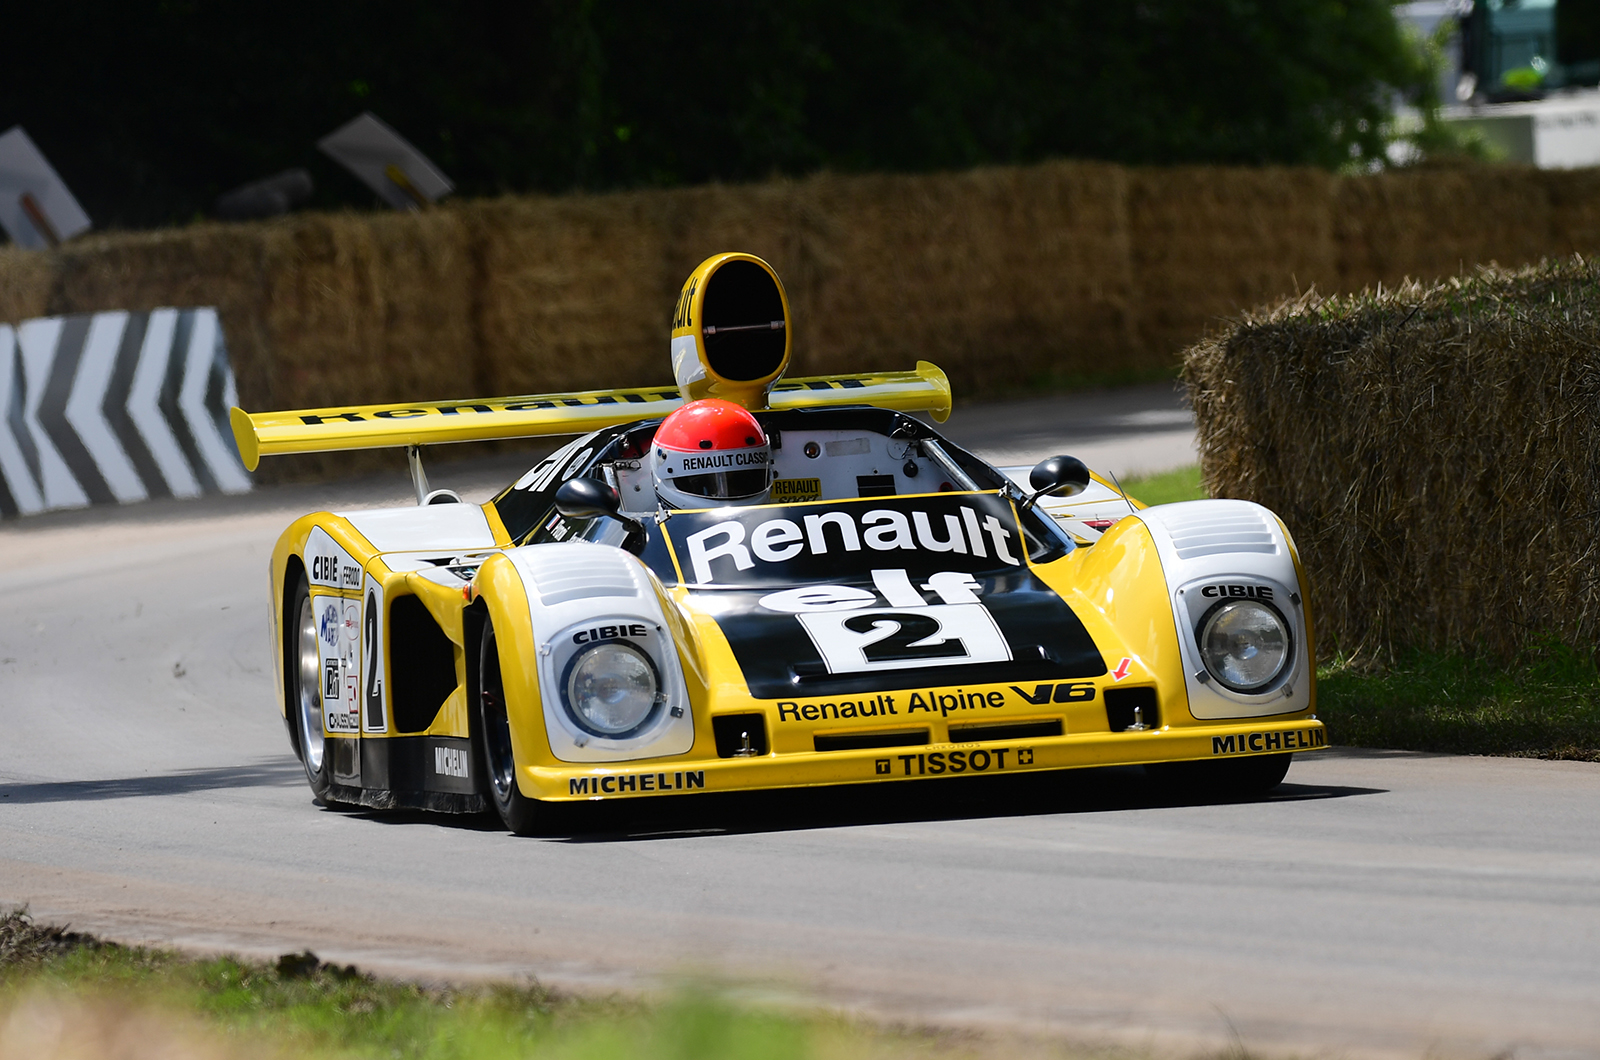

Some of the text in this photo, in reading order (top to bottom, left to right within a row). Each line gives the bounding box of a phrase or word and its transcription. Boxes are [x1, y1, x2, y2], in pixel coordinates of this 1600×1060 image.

[683, 454, 734, 470] RENAULT
[775, 479, 819, 494] RENAULT
[686, 506, 1020, 584] Renault
[758, 569, 983, 612] elf
[841, 612, 971, 664] 2
[364, 588, 385, 731] 2
[777, 682, 1096, 722] Renault Alpine V6
[1212, 729, 1324, 754] MICHELIN
[435, 747, 468, 778] MICHELIN
[898, 748, 1010, 776] TISSOT
[569, 771, 705, 795] MICHELIN
